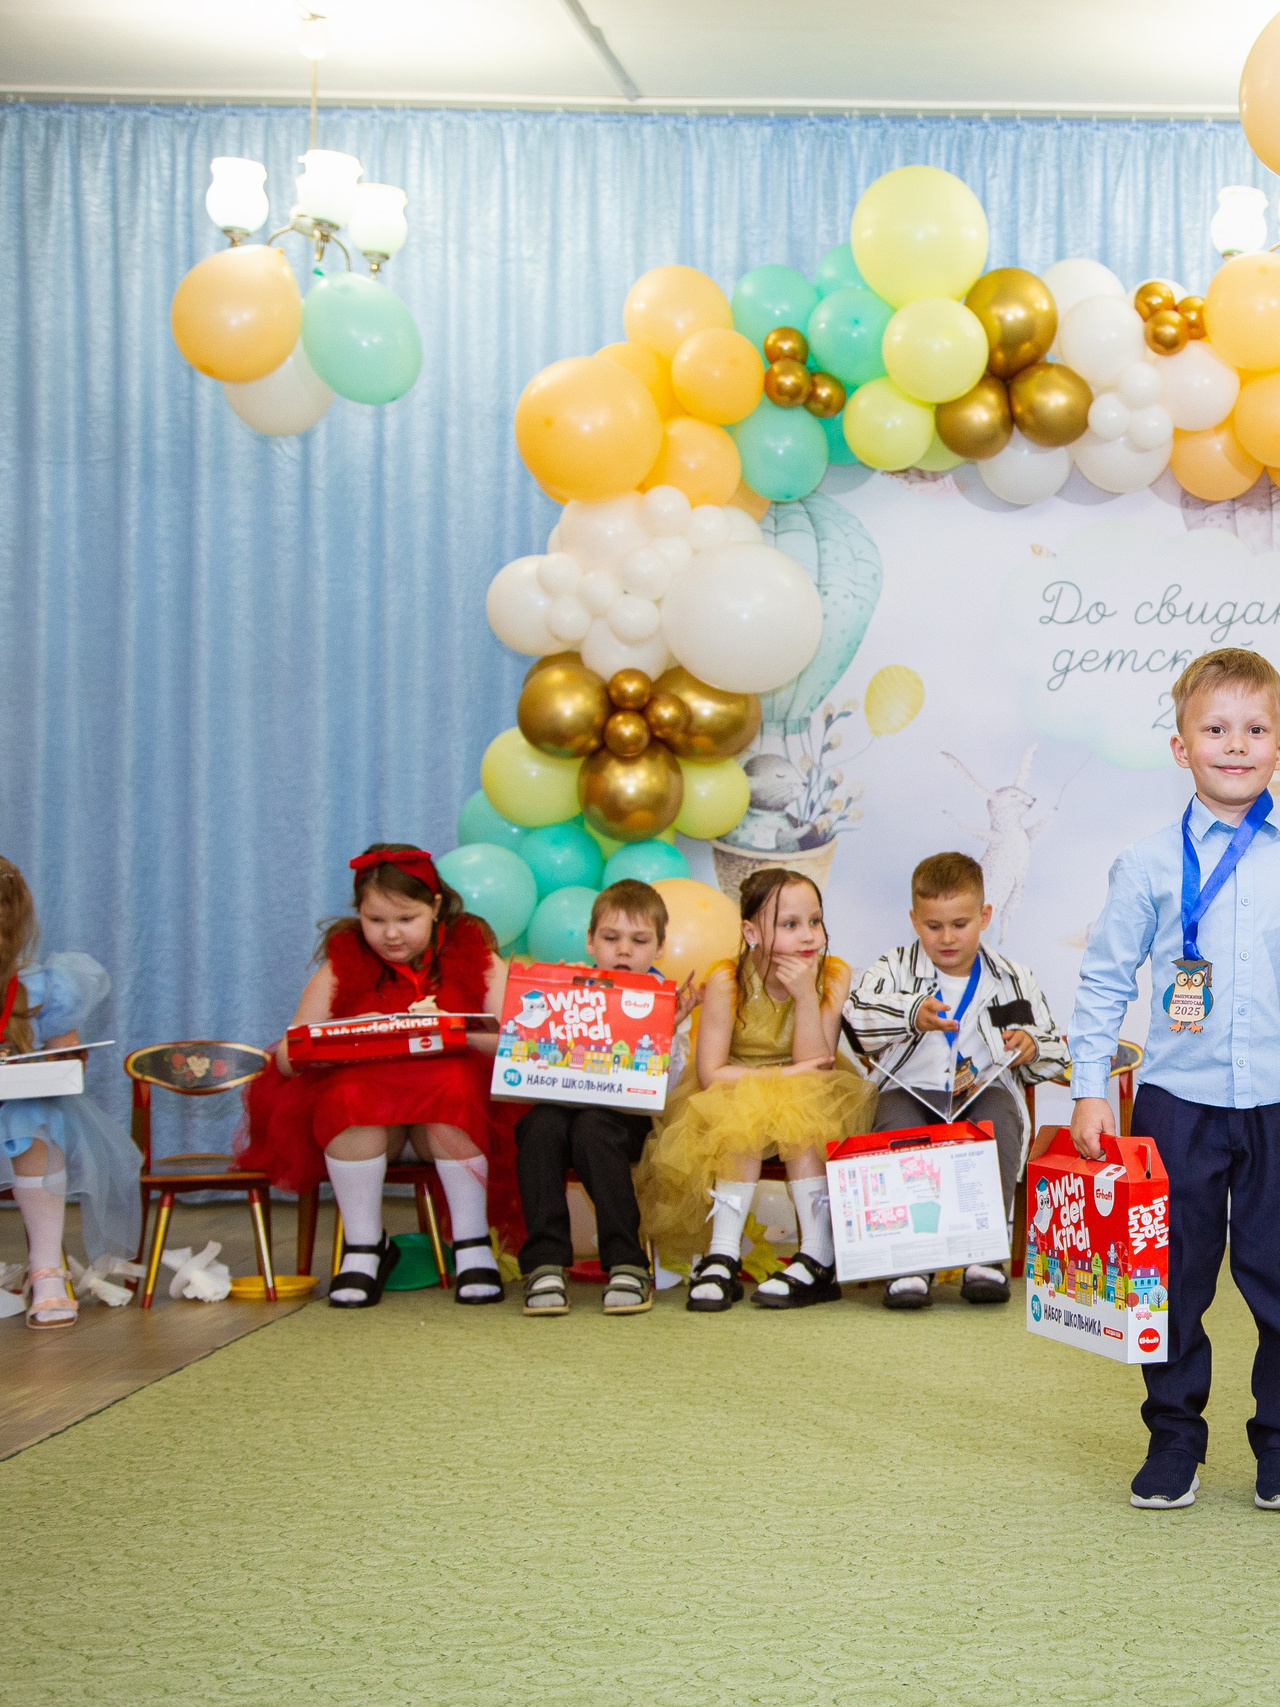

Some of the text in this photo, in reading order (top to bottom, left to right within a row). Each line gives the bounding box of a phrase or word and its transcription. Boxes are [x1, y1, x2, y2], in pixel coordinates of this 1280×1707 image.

[1039, 580, 1116, 625] До
[1047, 640, 1253, 691] детск
[563, 1003, 607, 1024] der
[1174, 1006, 1201, 1016] 2025
[549, 1018, 612, 1045] kind!
[526, 1074, 558, 1086] НАБОР
[561, 1077, 623, 1093] ШКОЛЬНИКА
[1060, 1197, 1086, 1228] der
[1138, 1205, 1155, 1239] der
[1052, 1223, 1092, 1258] kind!
[1043, 1303, 1062, 1323] НАБОР
[1064, 1309, 1102, 1336] ШКОЛЬНИКА
